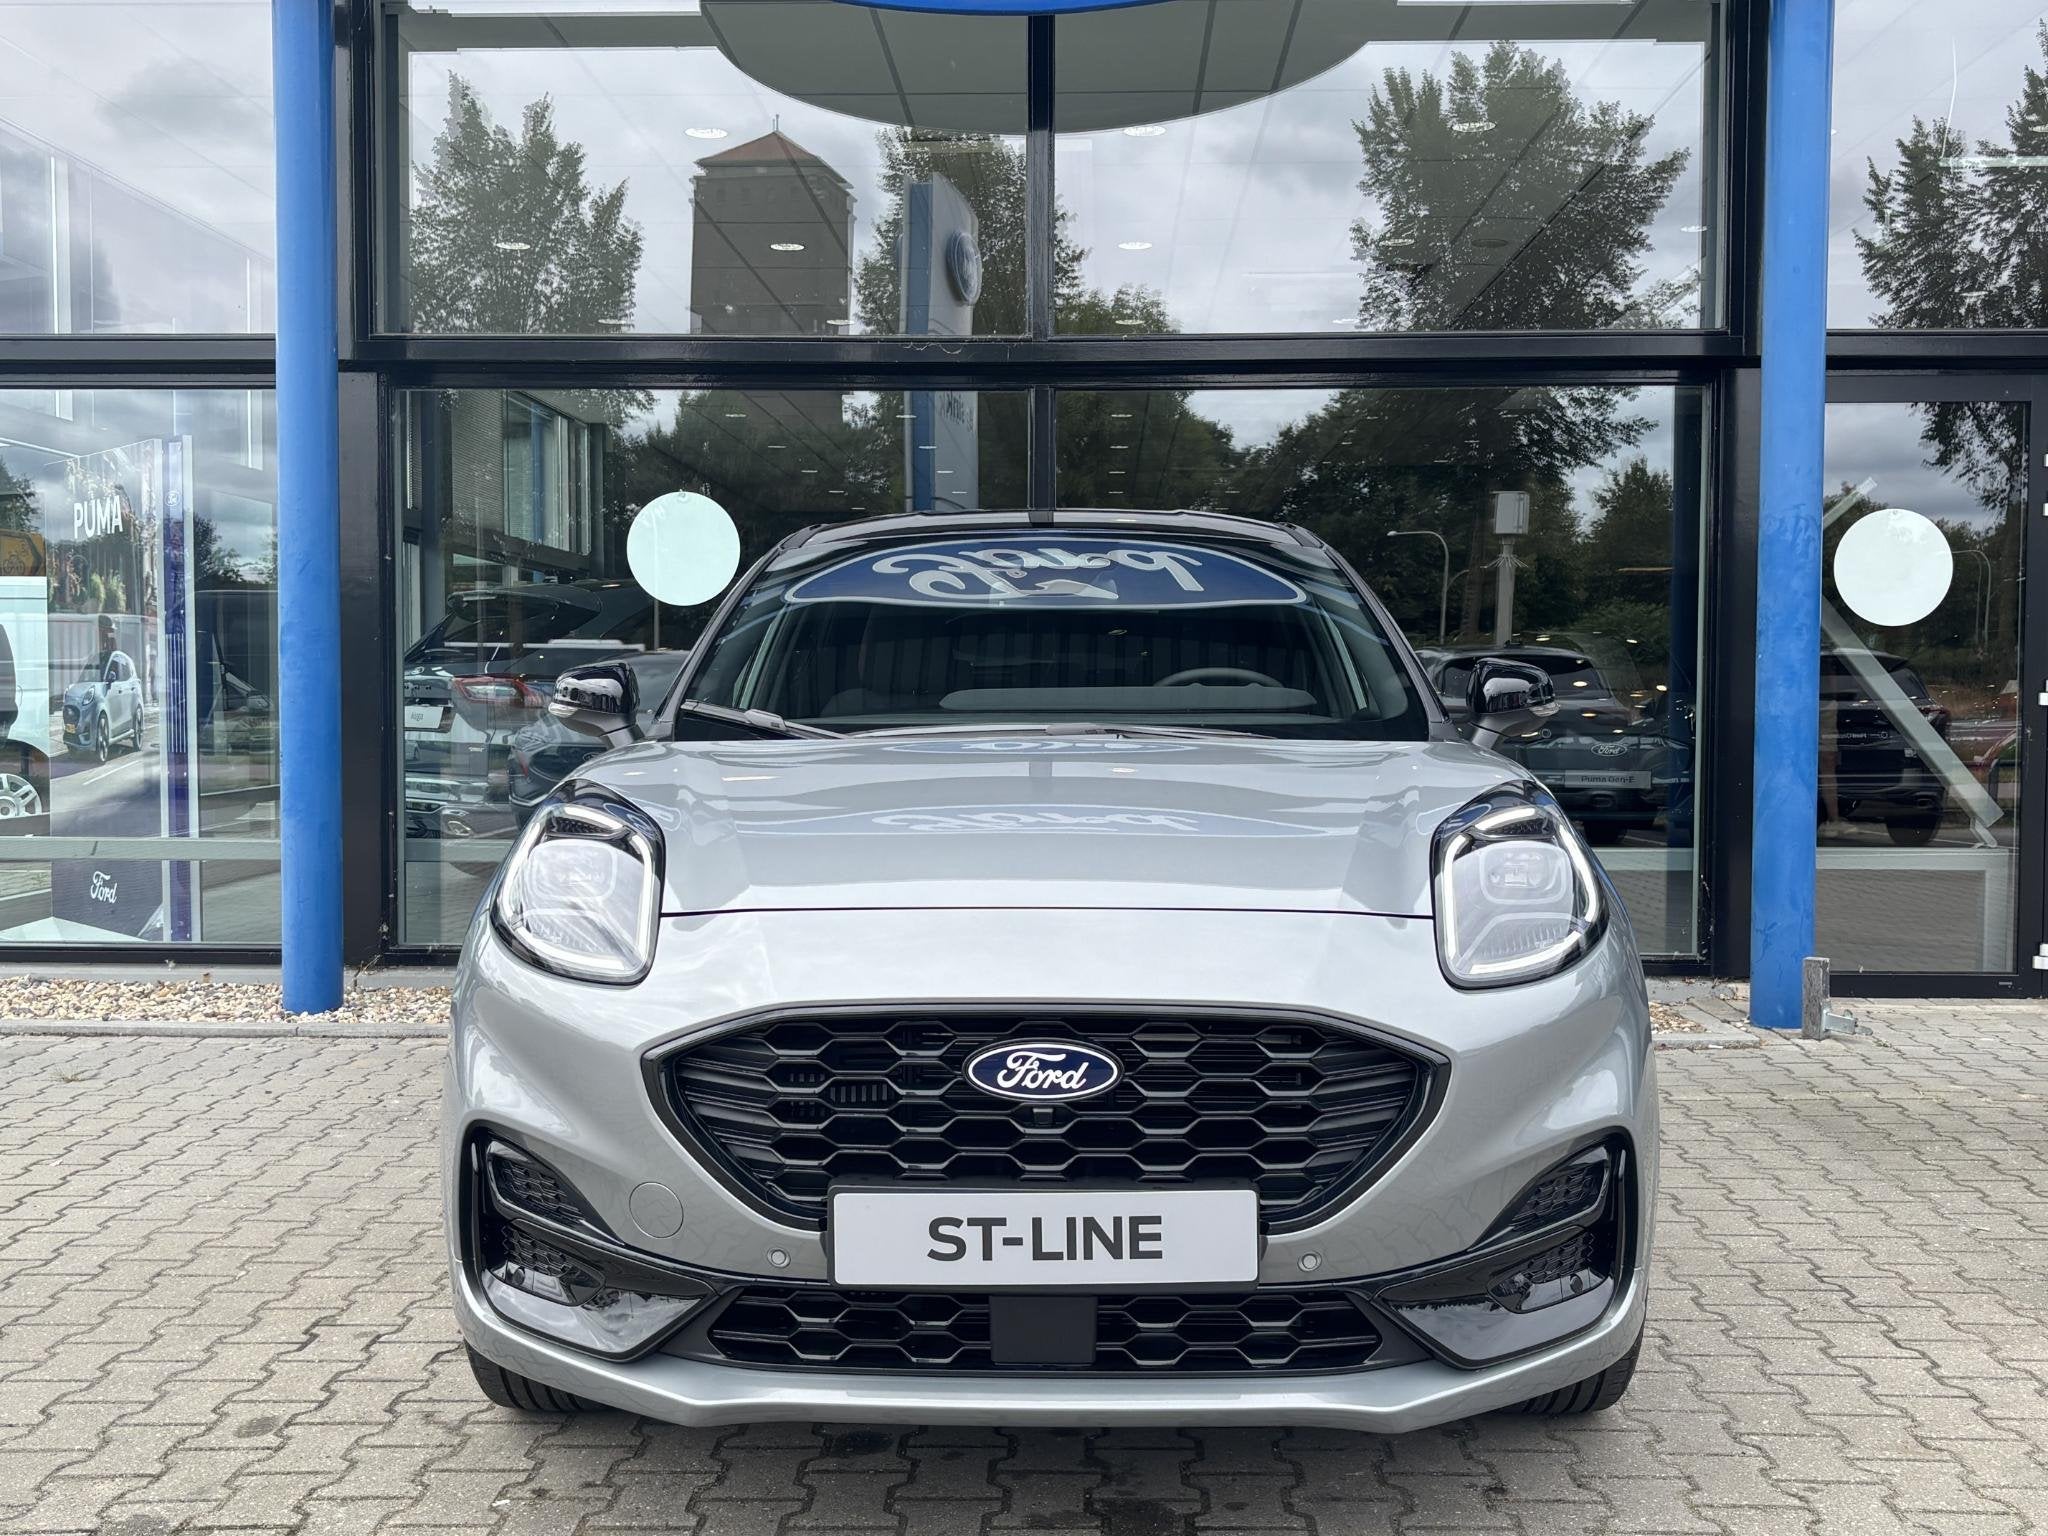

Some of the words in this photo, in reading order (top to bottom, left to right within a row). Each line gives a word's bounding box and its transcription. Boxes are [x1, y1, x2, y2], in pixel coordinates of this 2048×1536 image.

[73, 494, 124, 539] PUMA
[90, 870, 118, 903] Ford
[997, 1051, 1089, 1089] Ford
[926, 1215, 1163, 1262] ST-LINE
